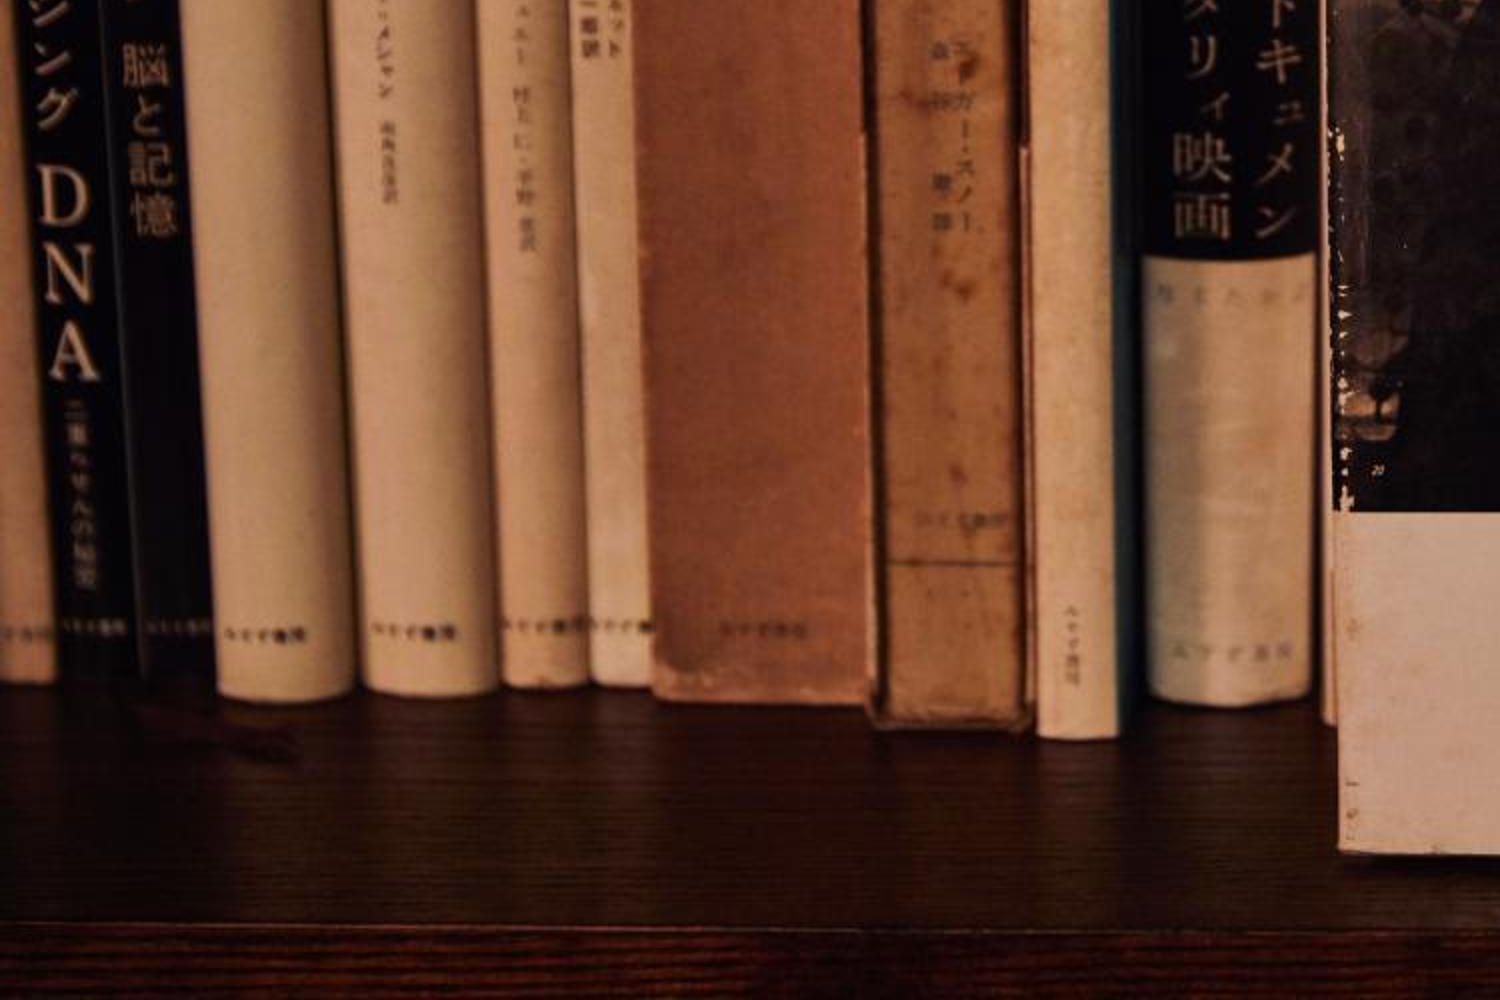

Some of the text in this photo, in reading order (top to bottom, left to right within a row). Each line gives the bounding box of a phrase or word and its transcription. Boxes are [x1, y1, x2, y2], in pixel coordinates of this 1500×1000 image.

[119, 39, 181, 241] 脳と記憶
[36, 160, 101, 384] DNA
